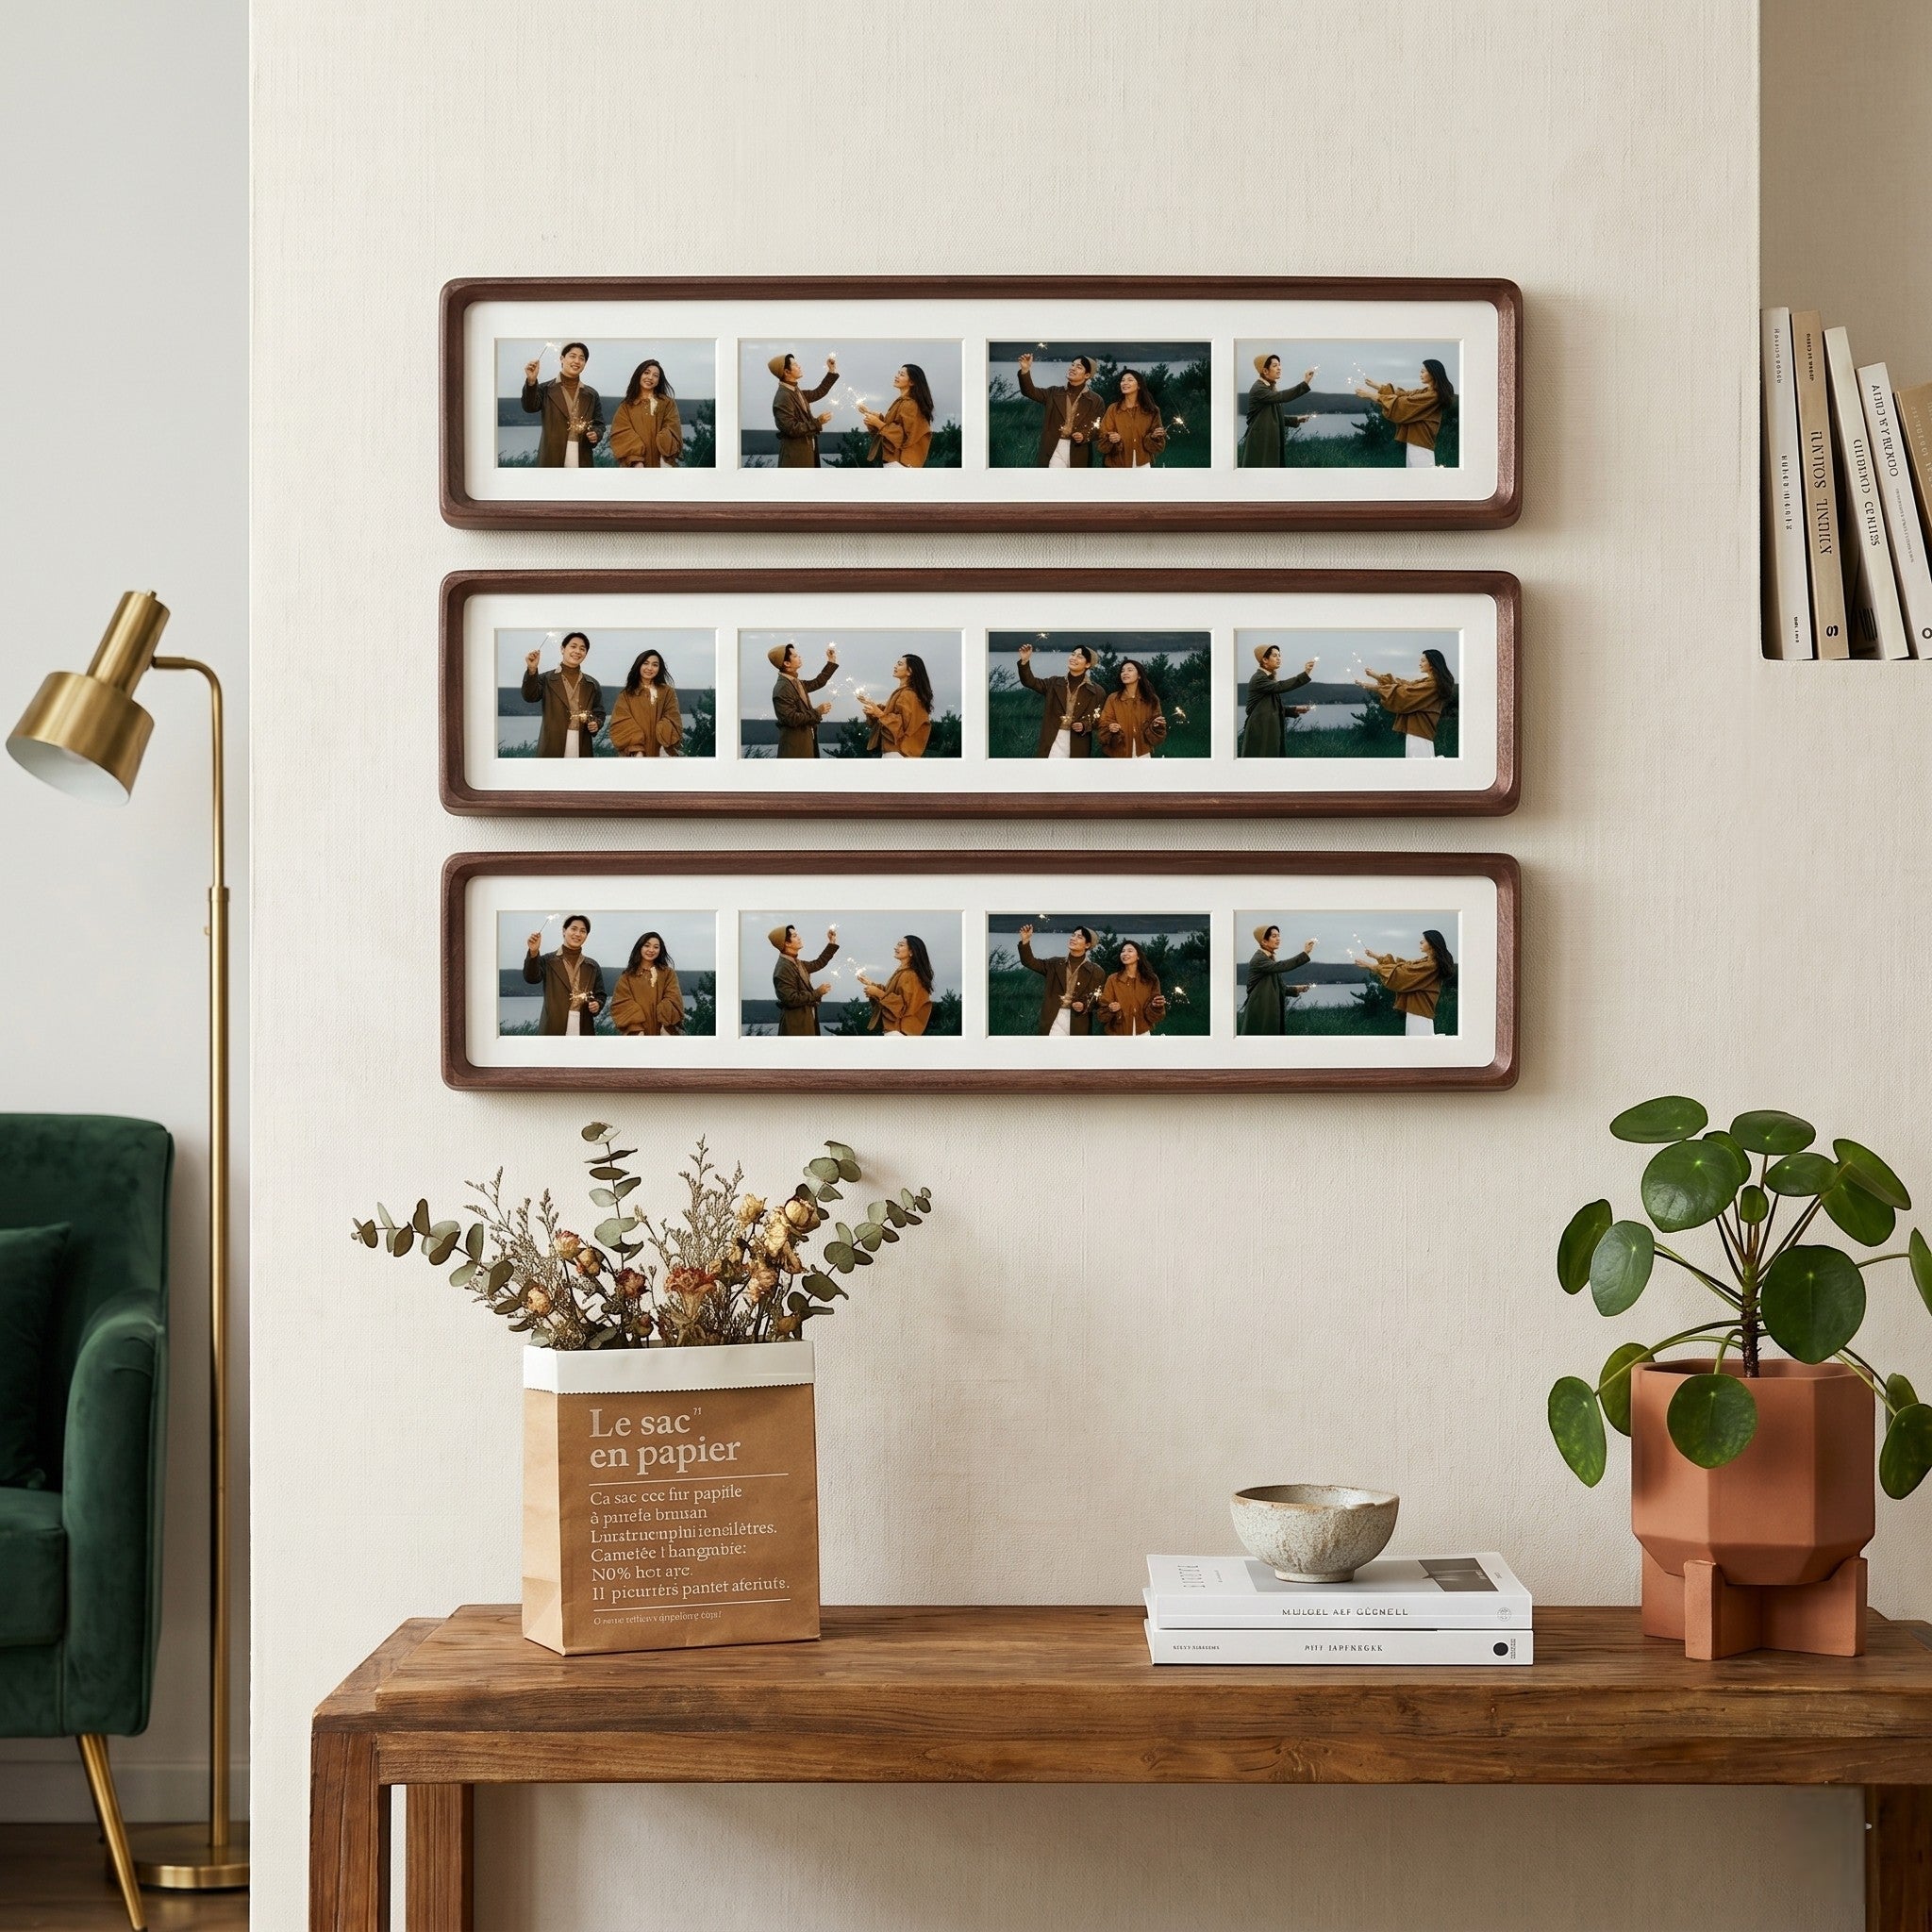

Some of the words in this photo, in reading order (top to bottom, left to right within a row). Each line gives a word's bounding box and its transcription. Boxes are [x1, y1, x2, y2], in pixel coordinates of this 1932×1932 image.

[590, 1408, 632, 1438] Le
[590, 1447, 630, 1469] en
[637, 1436, 741, 1475] papier
[614, 1493, 638, 1505] sac
